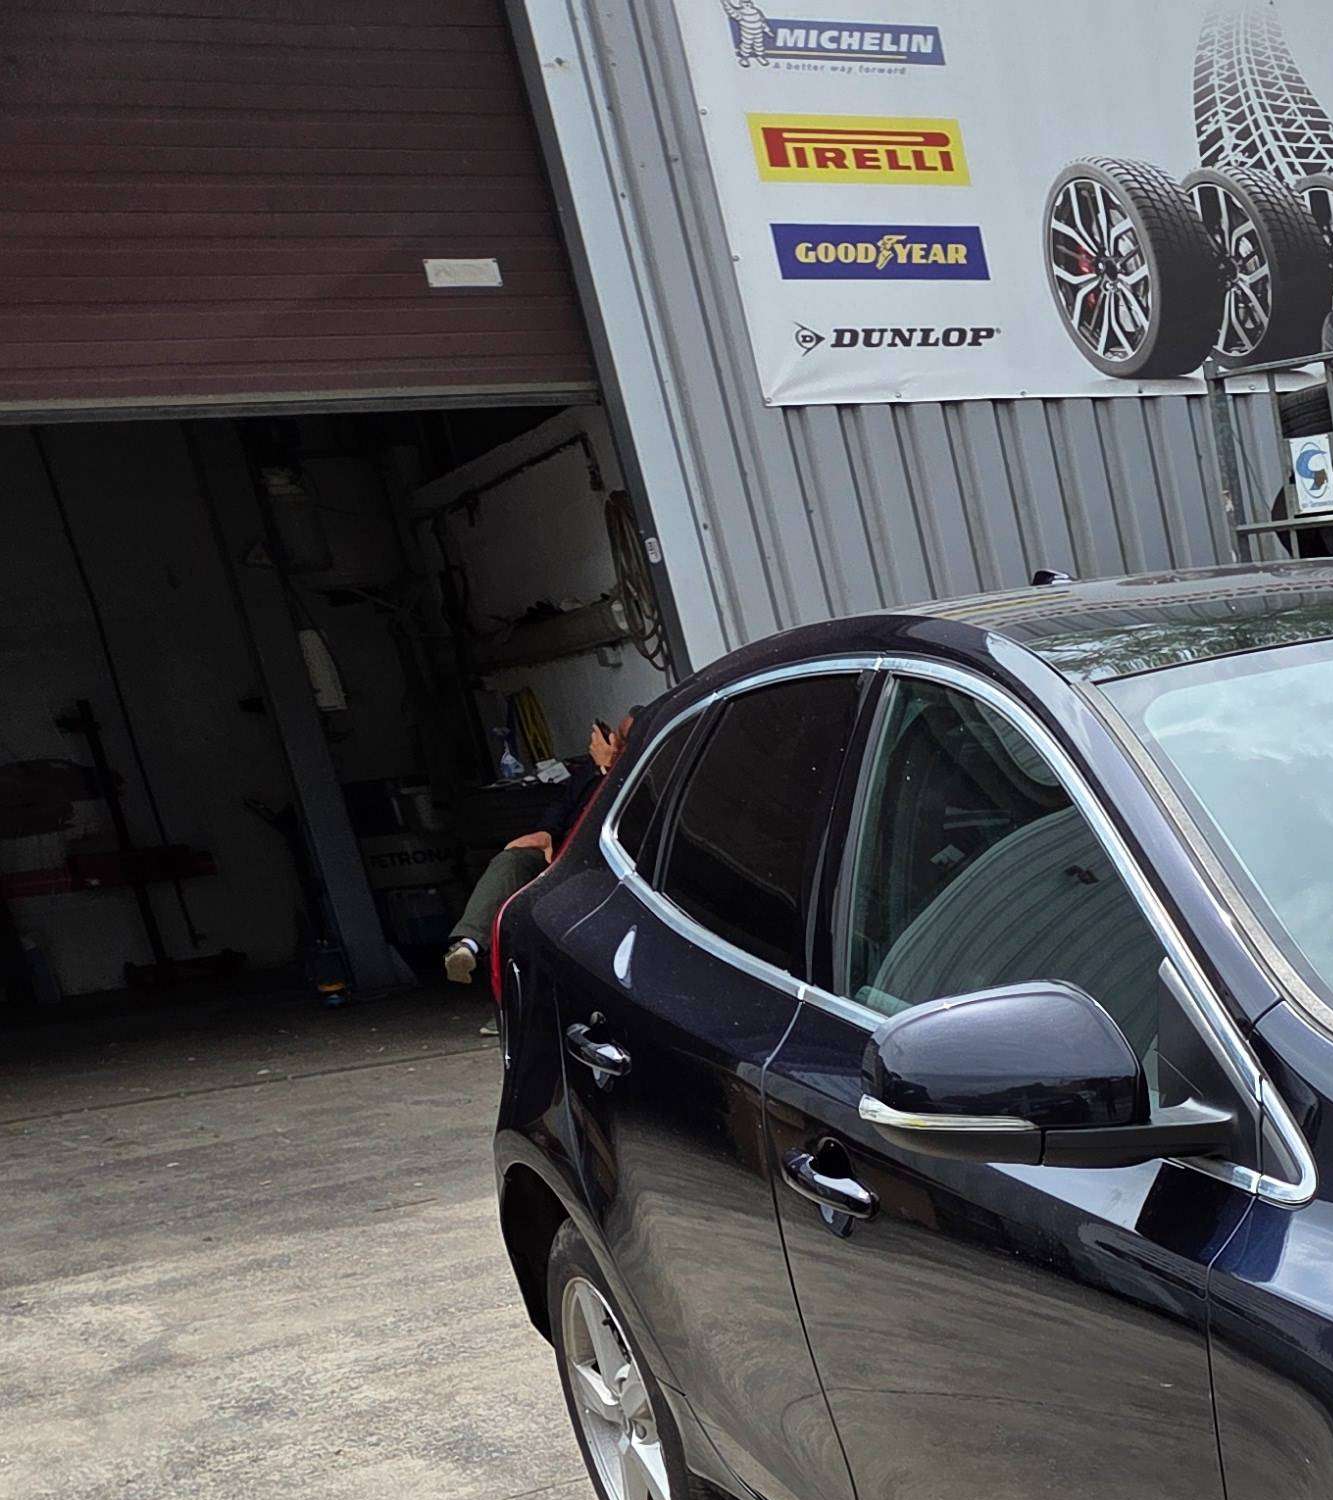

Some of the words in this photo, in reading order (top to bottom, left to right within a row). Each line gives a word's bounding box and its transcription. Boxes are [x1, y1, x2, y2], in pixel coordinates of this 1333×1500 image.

[775, 27, 934, 53] MICHELIN
[786, 61, 825, 72] better
[830, 65, 853, 75] way
[858, 64, 907, 76] forward
[761, 126, 955, 172] PIRELLI
[794, 242, 968, 265] GOODYEAR
[830, 327, 996, 349] DUNLOP
